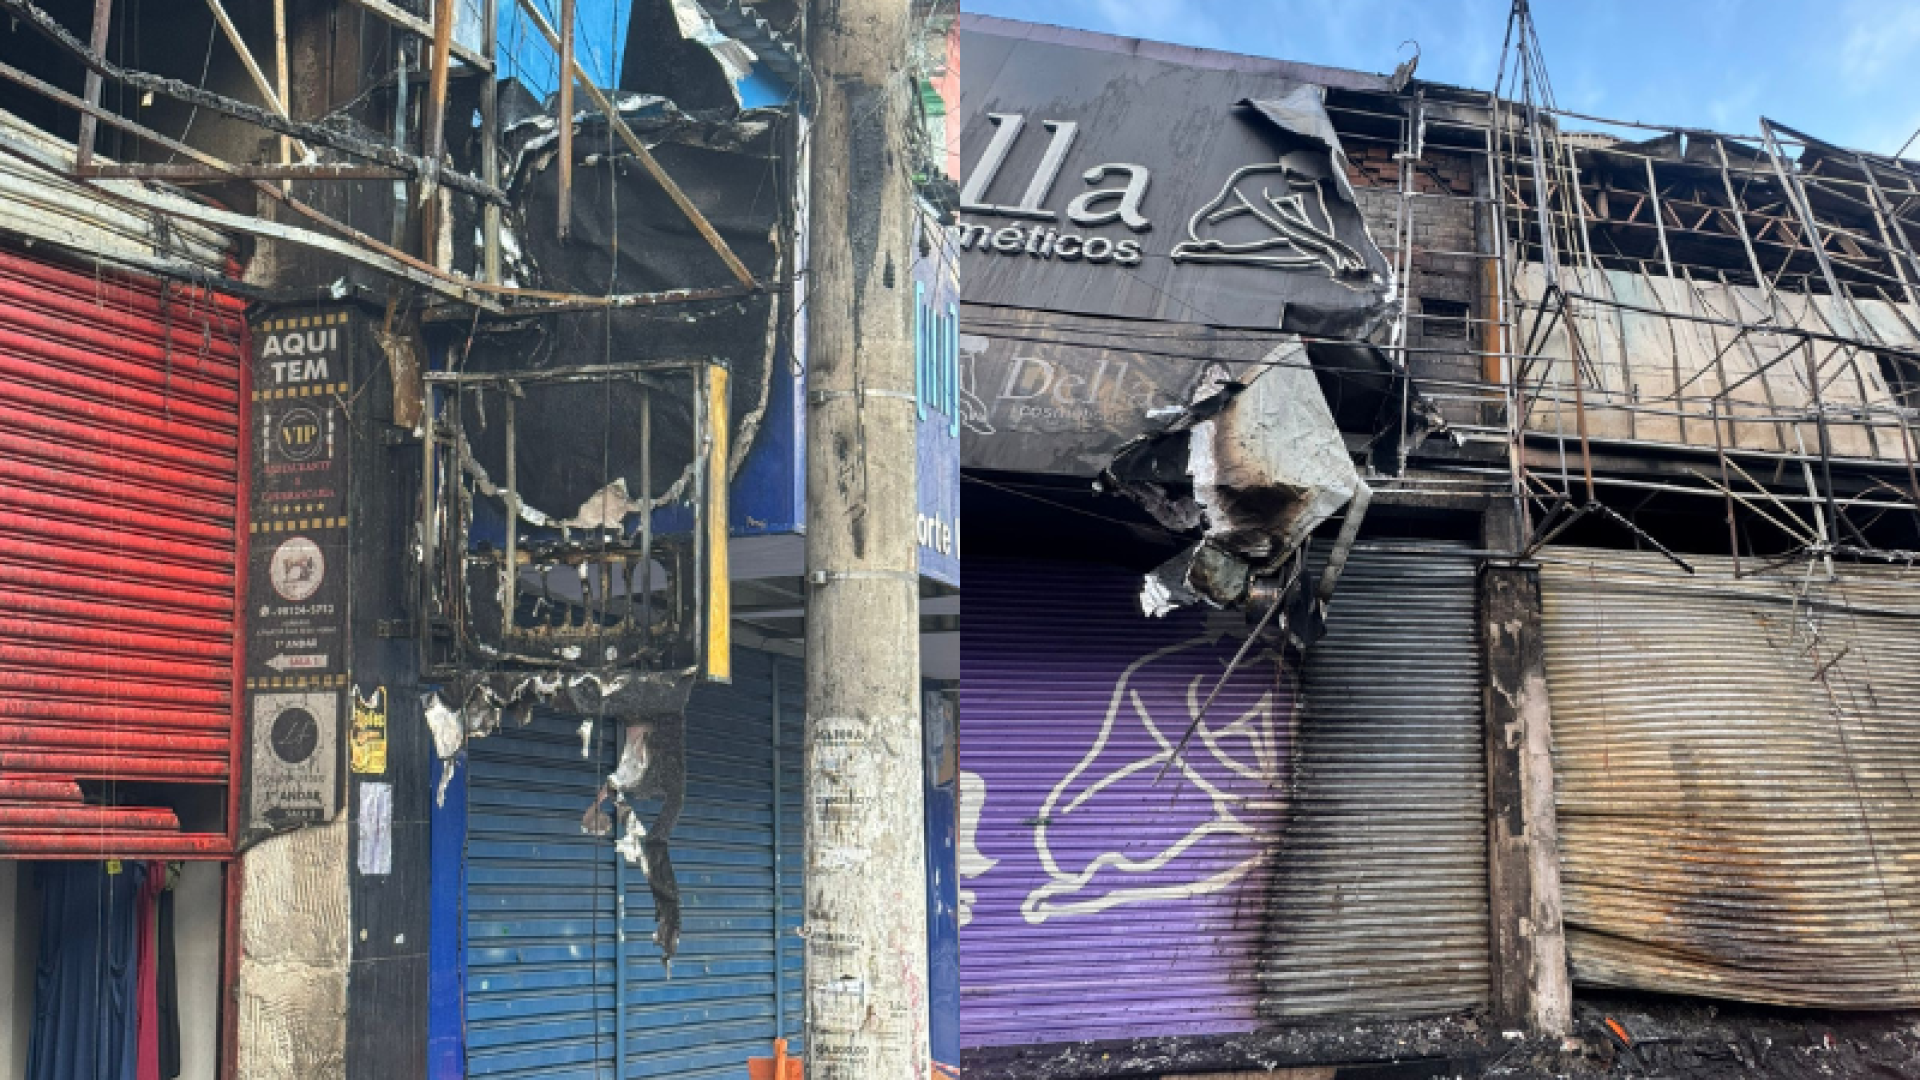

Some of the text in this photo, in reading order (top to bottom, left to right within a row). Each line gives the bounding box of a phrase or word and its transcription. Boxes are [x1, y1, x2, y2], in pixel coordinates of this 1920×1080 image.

[262, 328, 337, 358] AQUI
[271, 357, 330, 384] TEM
[282, 425, 318, 445] VIP
[286, 637, 318, 649] ANDAR
[280, 790, 321, 801] ANDAR
